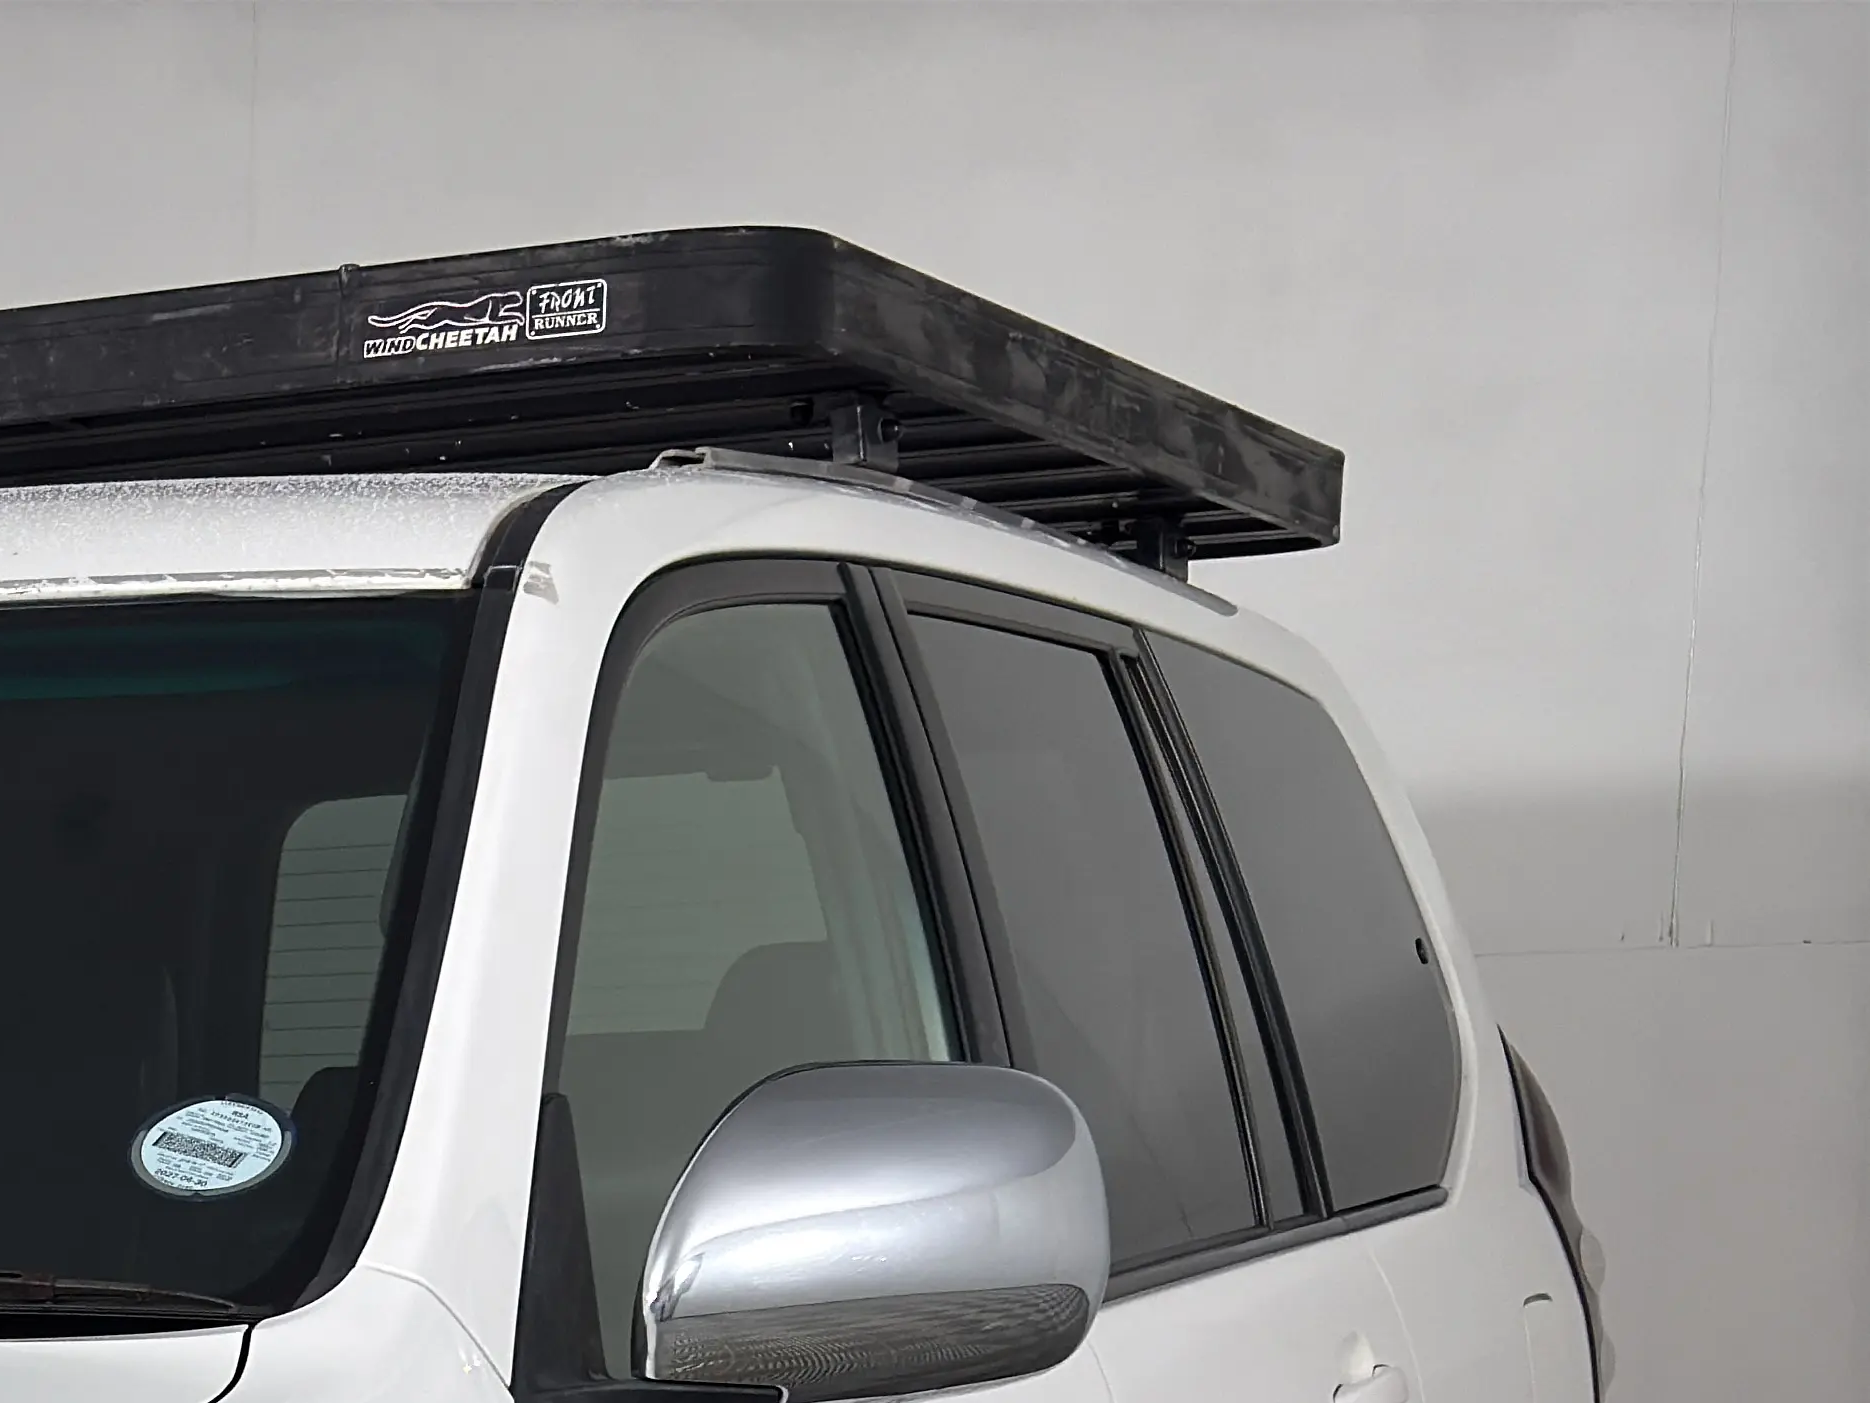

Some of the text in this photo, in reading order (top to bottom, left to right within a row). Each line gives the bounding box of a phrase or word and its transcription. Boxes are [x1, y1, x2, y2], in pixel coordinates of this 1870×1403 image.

[539, 286, 595, 313] FRONT
[534, 312, 598, 330] RUNNER
[364, 324, 519, 359] WINDCHEETAH
